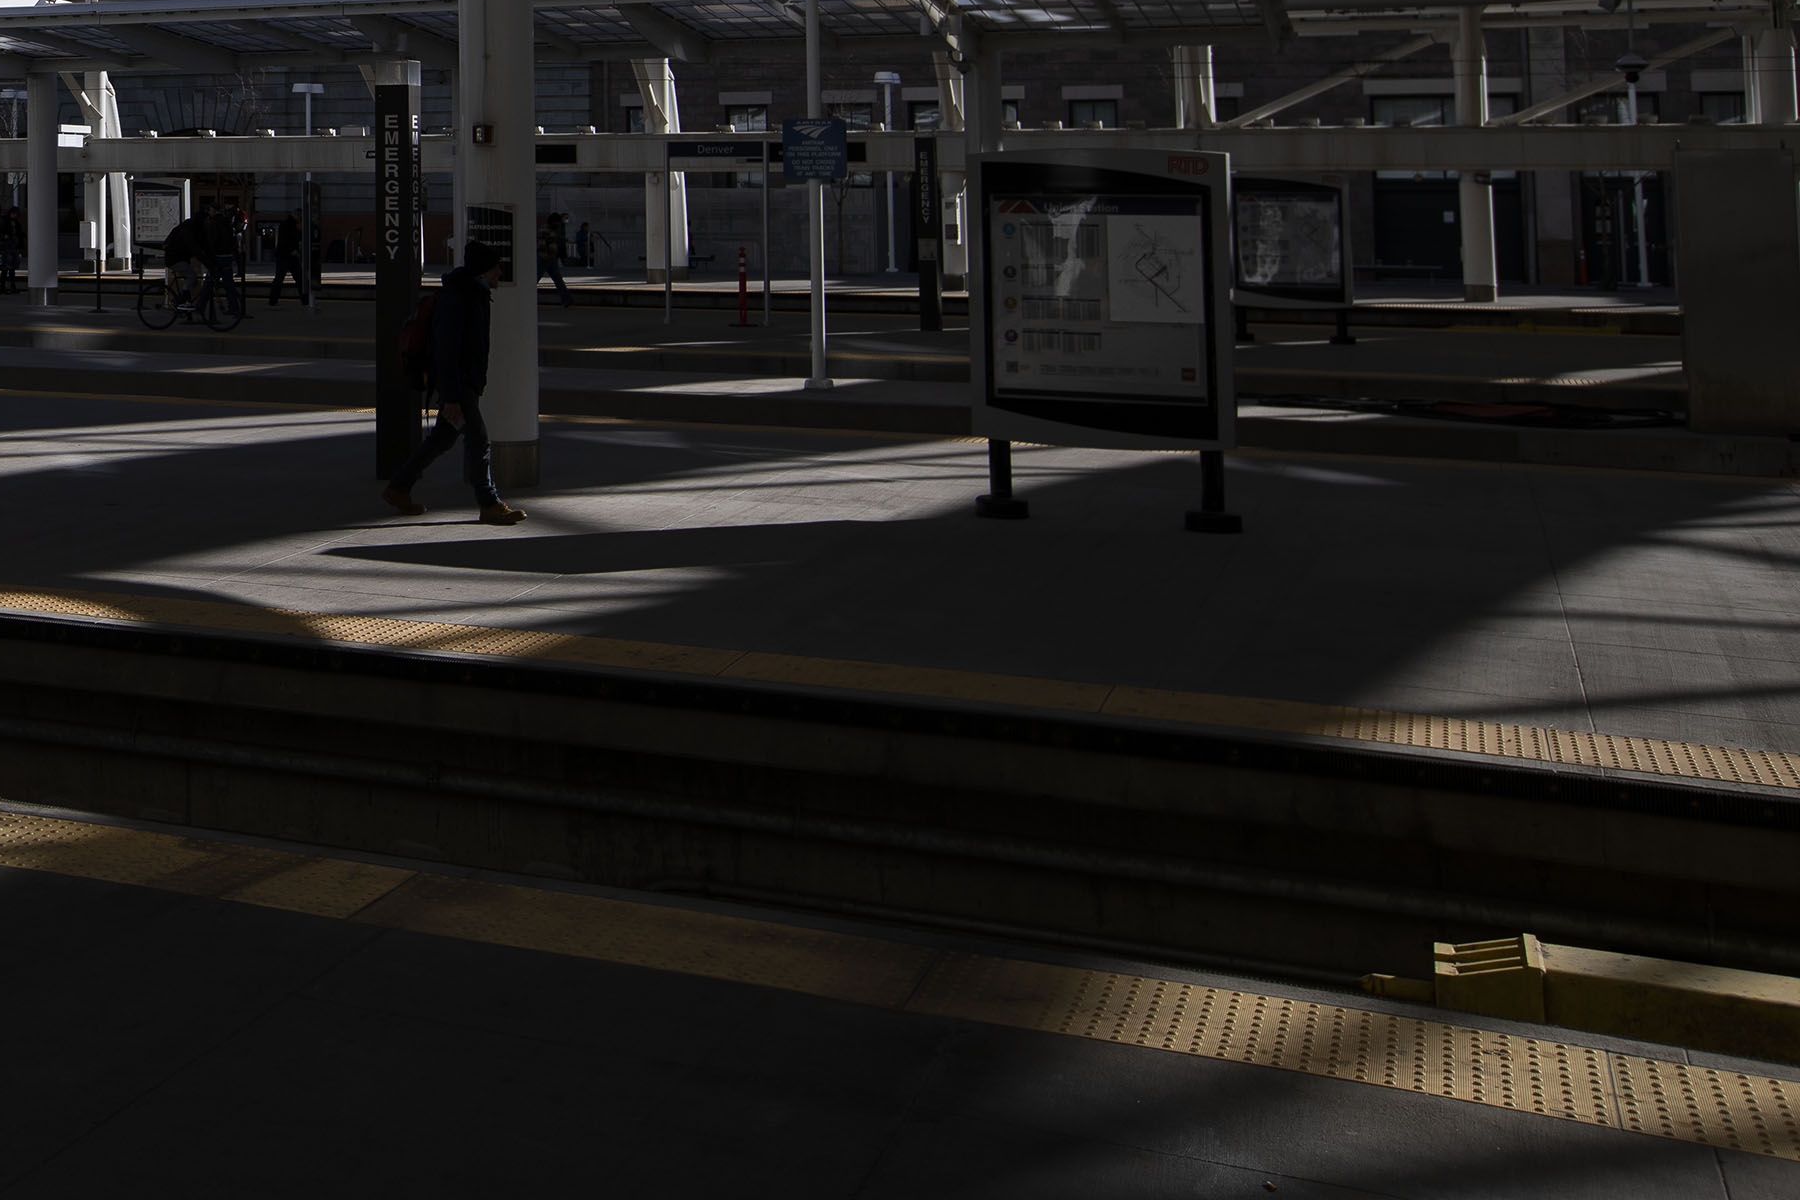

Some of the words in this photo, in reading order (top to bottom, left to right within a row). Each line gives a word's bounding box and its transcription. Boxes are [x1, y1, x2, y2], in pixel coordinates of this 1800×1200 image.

[697, 144, 734, 154] Denver
[1167, 156, 1209, 175] RTD
[384, 114, 400, 262] EMERGENCY
[411, 114, 419, 262] EMERGENCY
[920, 152, 930, 224] EMERGENCY
